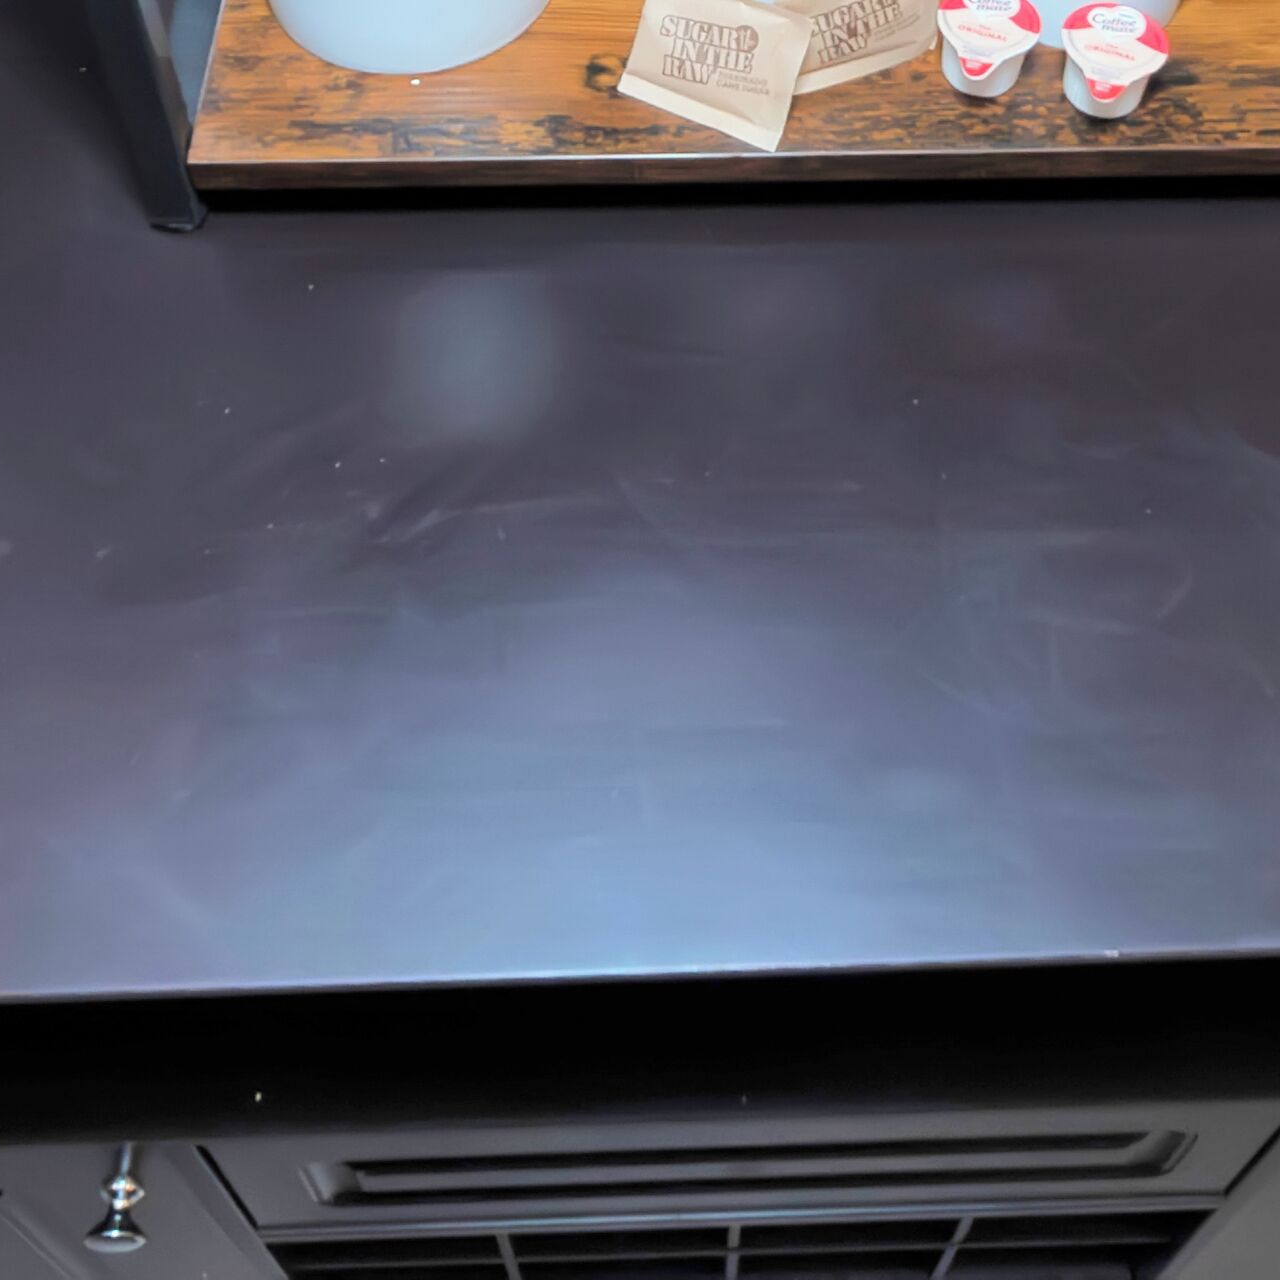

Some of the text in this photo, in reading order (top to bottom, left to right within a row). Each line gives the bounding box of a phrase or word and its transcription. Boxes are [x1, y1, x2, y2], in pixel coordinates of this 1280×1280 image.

[660, 15, 740, 52] SUGAR
[1092, 13, 1137, 26] Coffee
[1102, 25, 1137, 33] mate
[671, 36, 754, 74] IN THE
[817, 33, 868, 63] RAW
[662, 54, 716, 85] RAW
